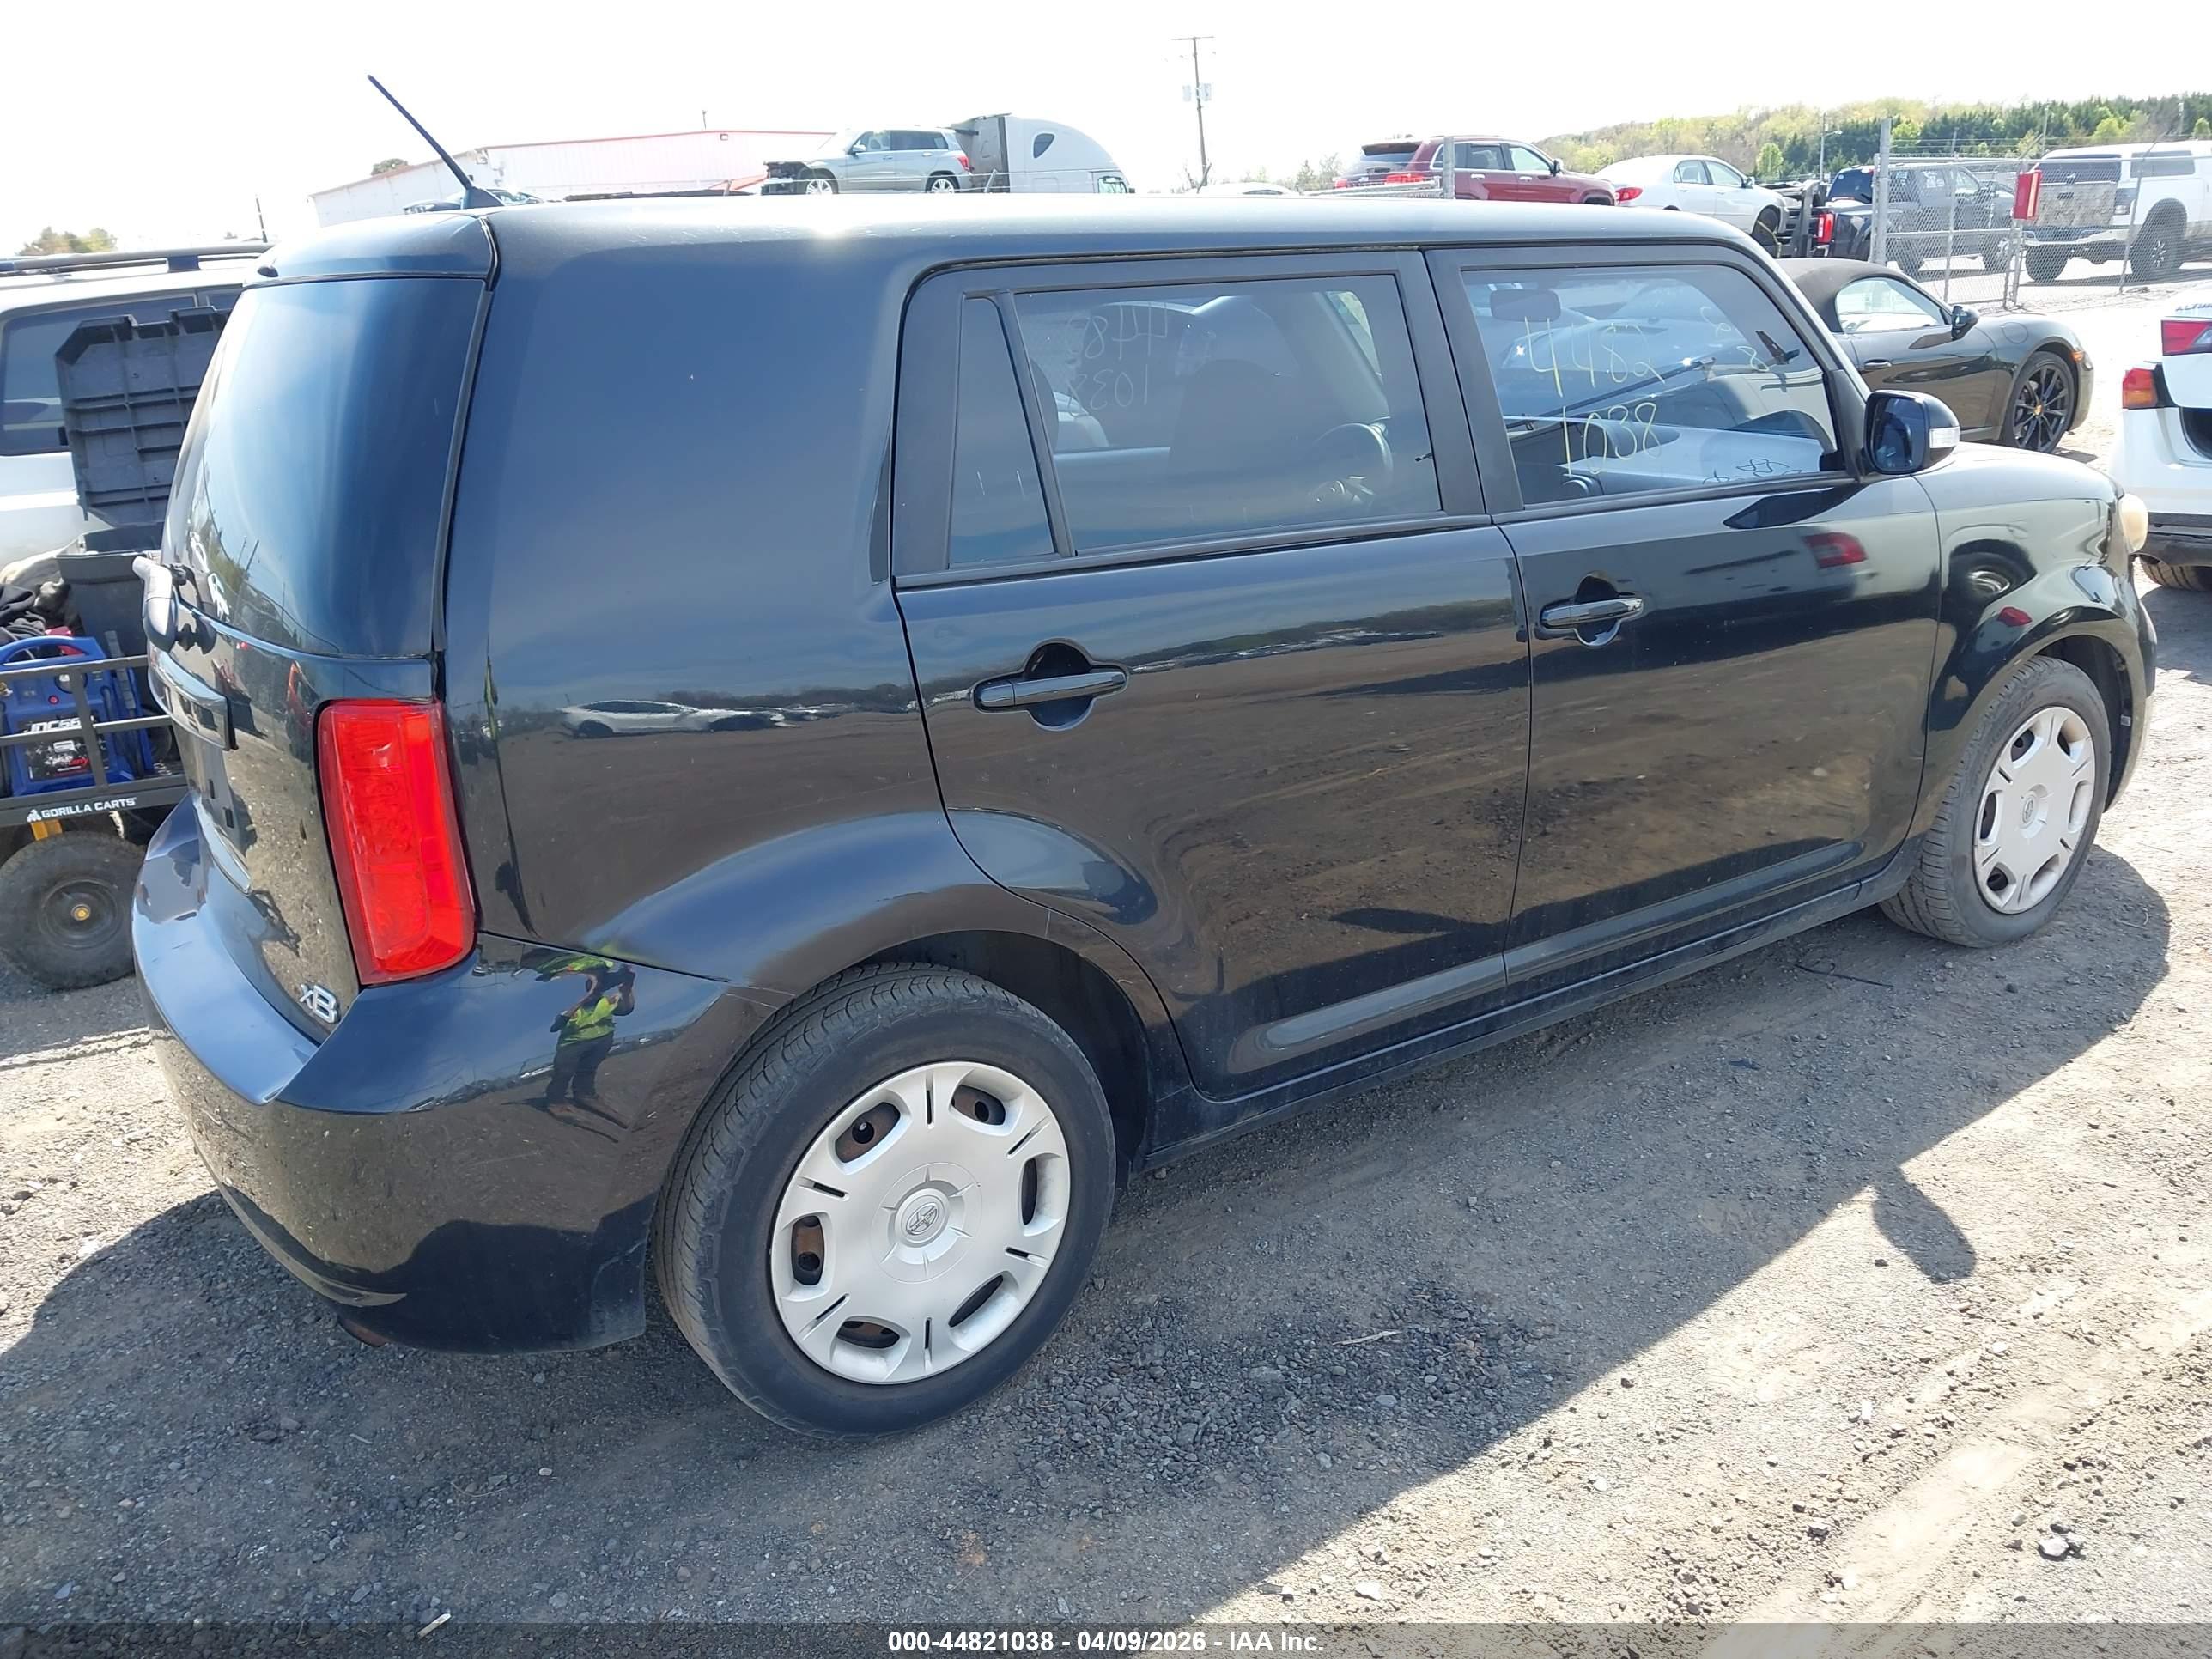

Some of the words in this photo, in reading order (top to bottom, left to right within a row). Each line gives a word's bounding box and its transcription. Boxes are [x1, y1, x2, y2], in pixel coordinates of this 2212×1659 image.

[1563, 402, 1662, 477] 1038
[40, 803, 93, 818] GORILLA
[94, 797, 137, 811] CARTS
[299, 983, 337, 1024] xB
